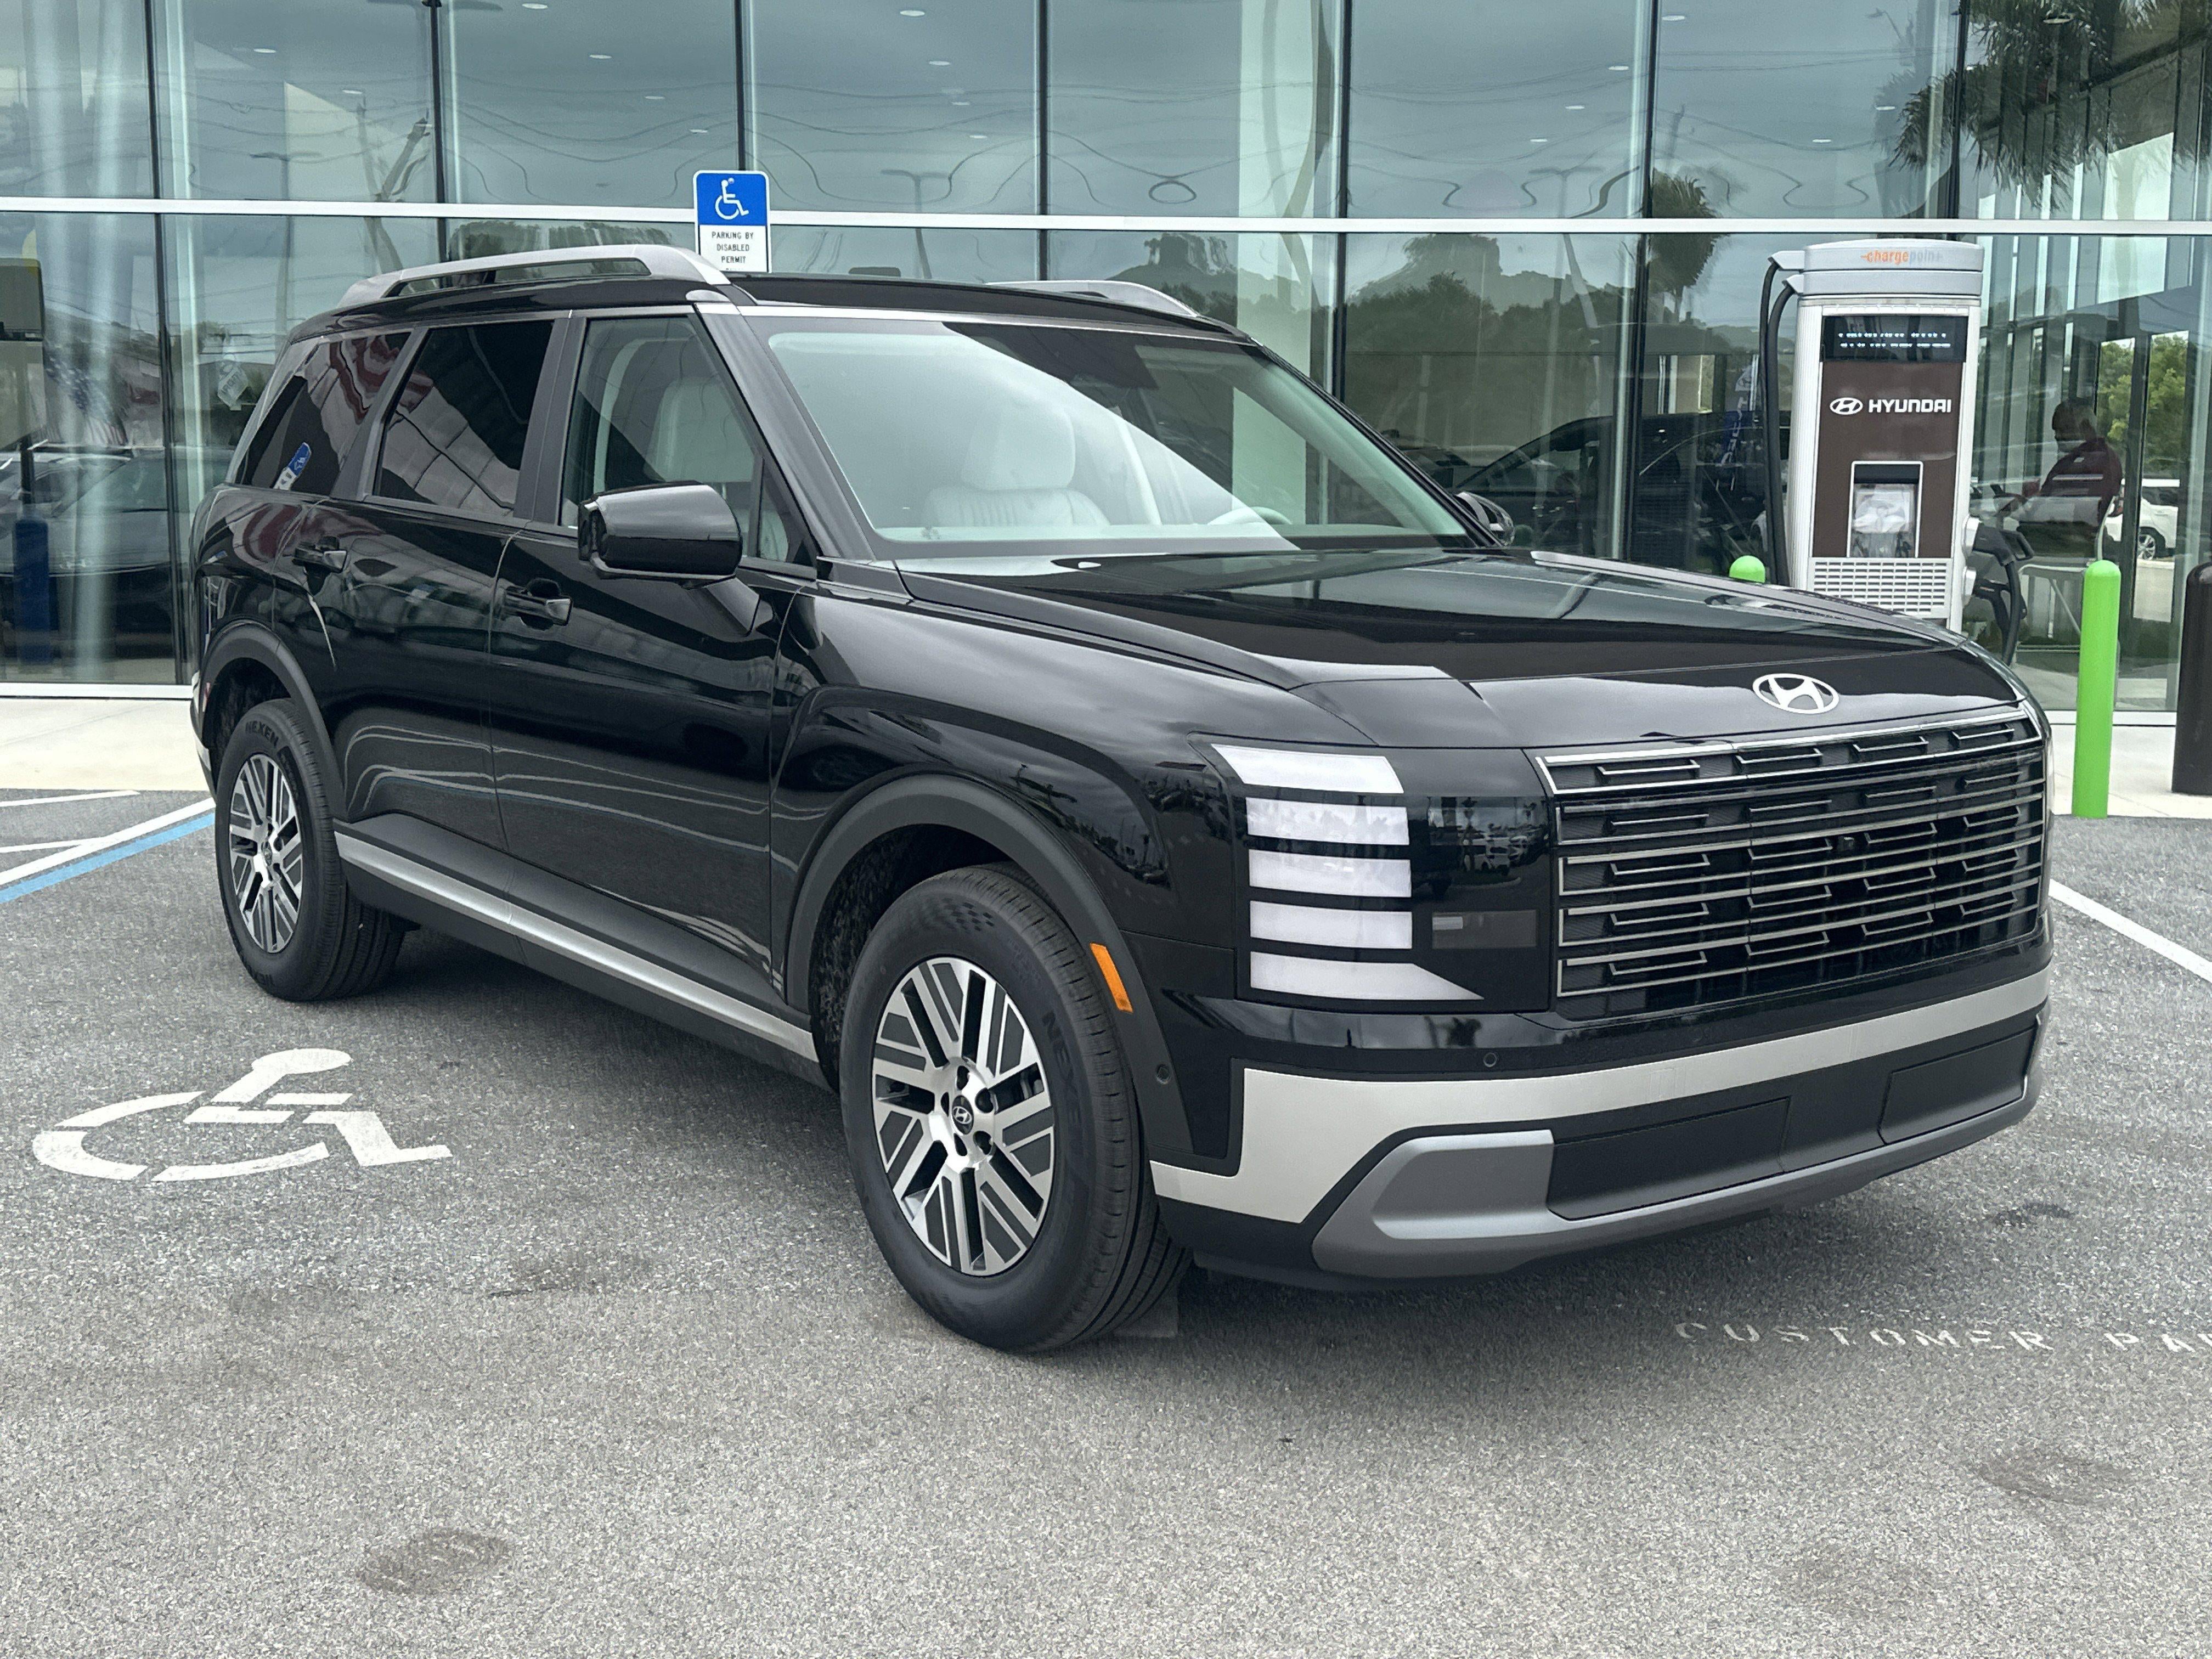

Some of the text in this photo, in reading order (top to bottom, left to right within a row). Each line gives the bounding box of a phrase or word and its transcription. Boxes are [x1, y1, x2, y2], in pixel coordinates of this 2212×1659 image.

[712, 231, 742, 239] PARKING
[1869, 399, 1952, 413] HYUNDAI
[245, 720, 279, 747] NEXEN
[1675, 1322, 2054, 1351] CUSTOMER
